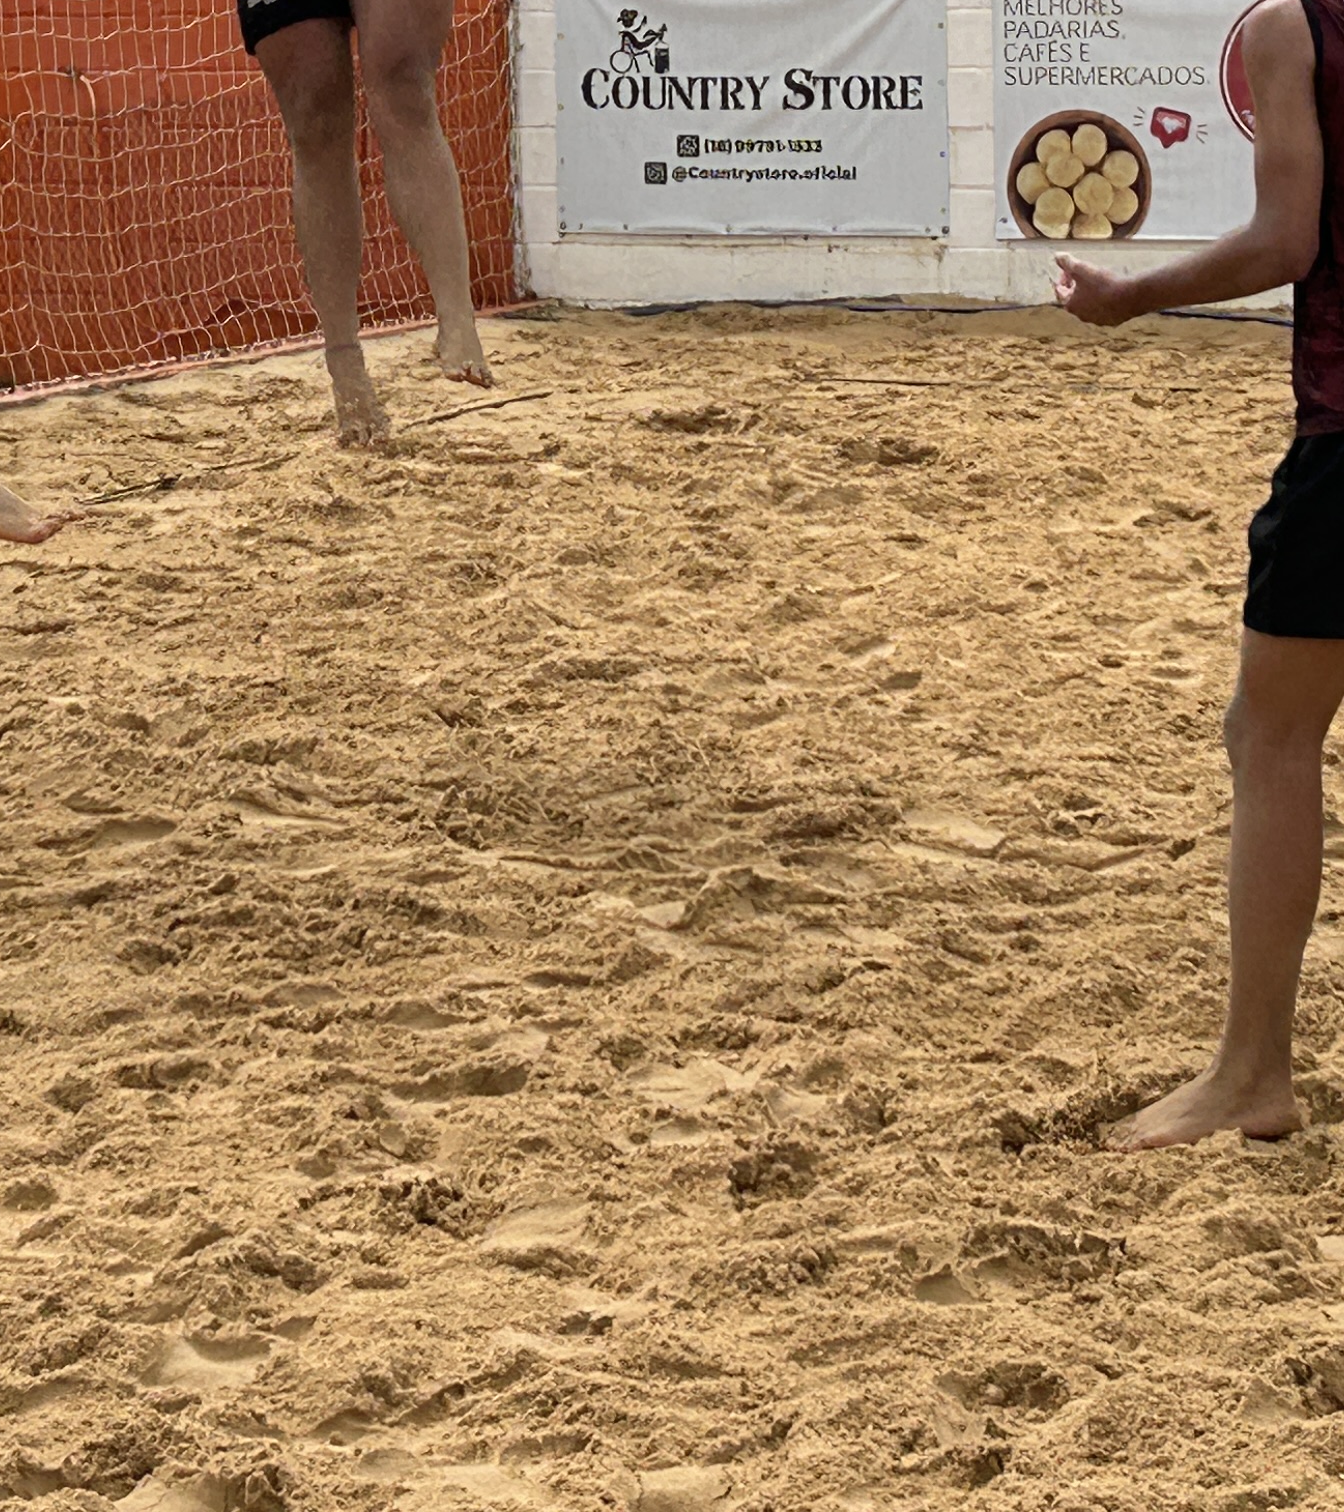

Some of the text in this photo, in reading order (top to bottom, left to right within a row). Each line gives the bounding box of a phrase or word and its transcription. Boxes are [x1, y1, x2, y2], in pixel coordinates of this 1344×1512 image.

[1003, 40, 1091, 63] CAFÉS E
[581, 68, 924, 110] COUNTRY STORE
